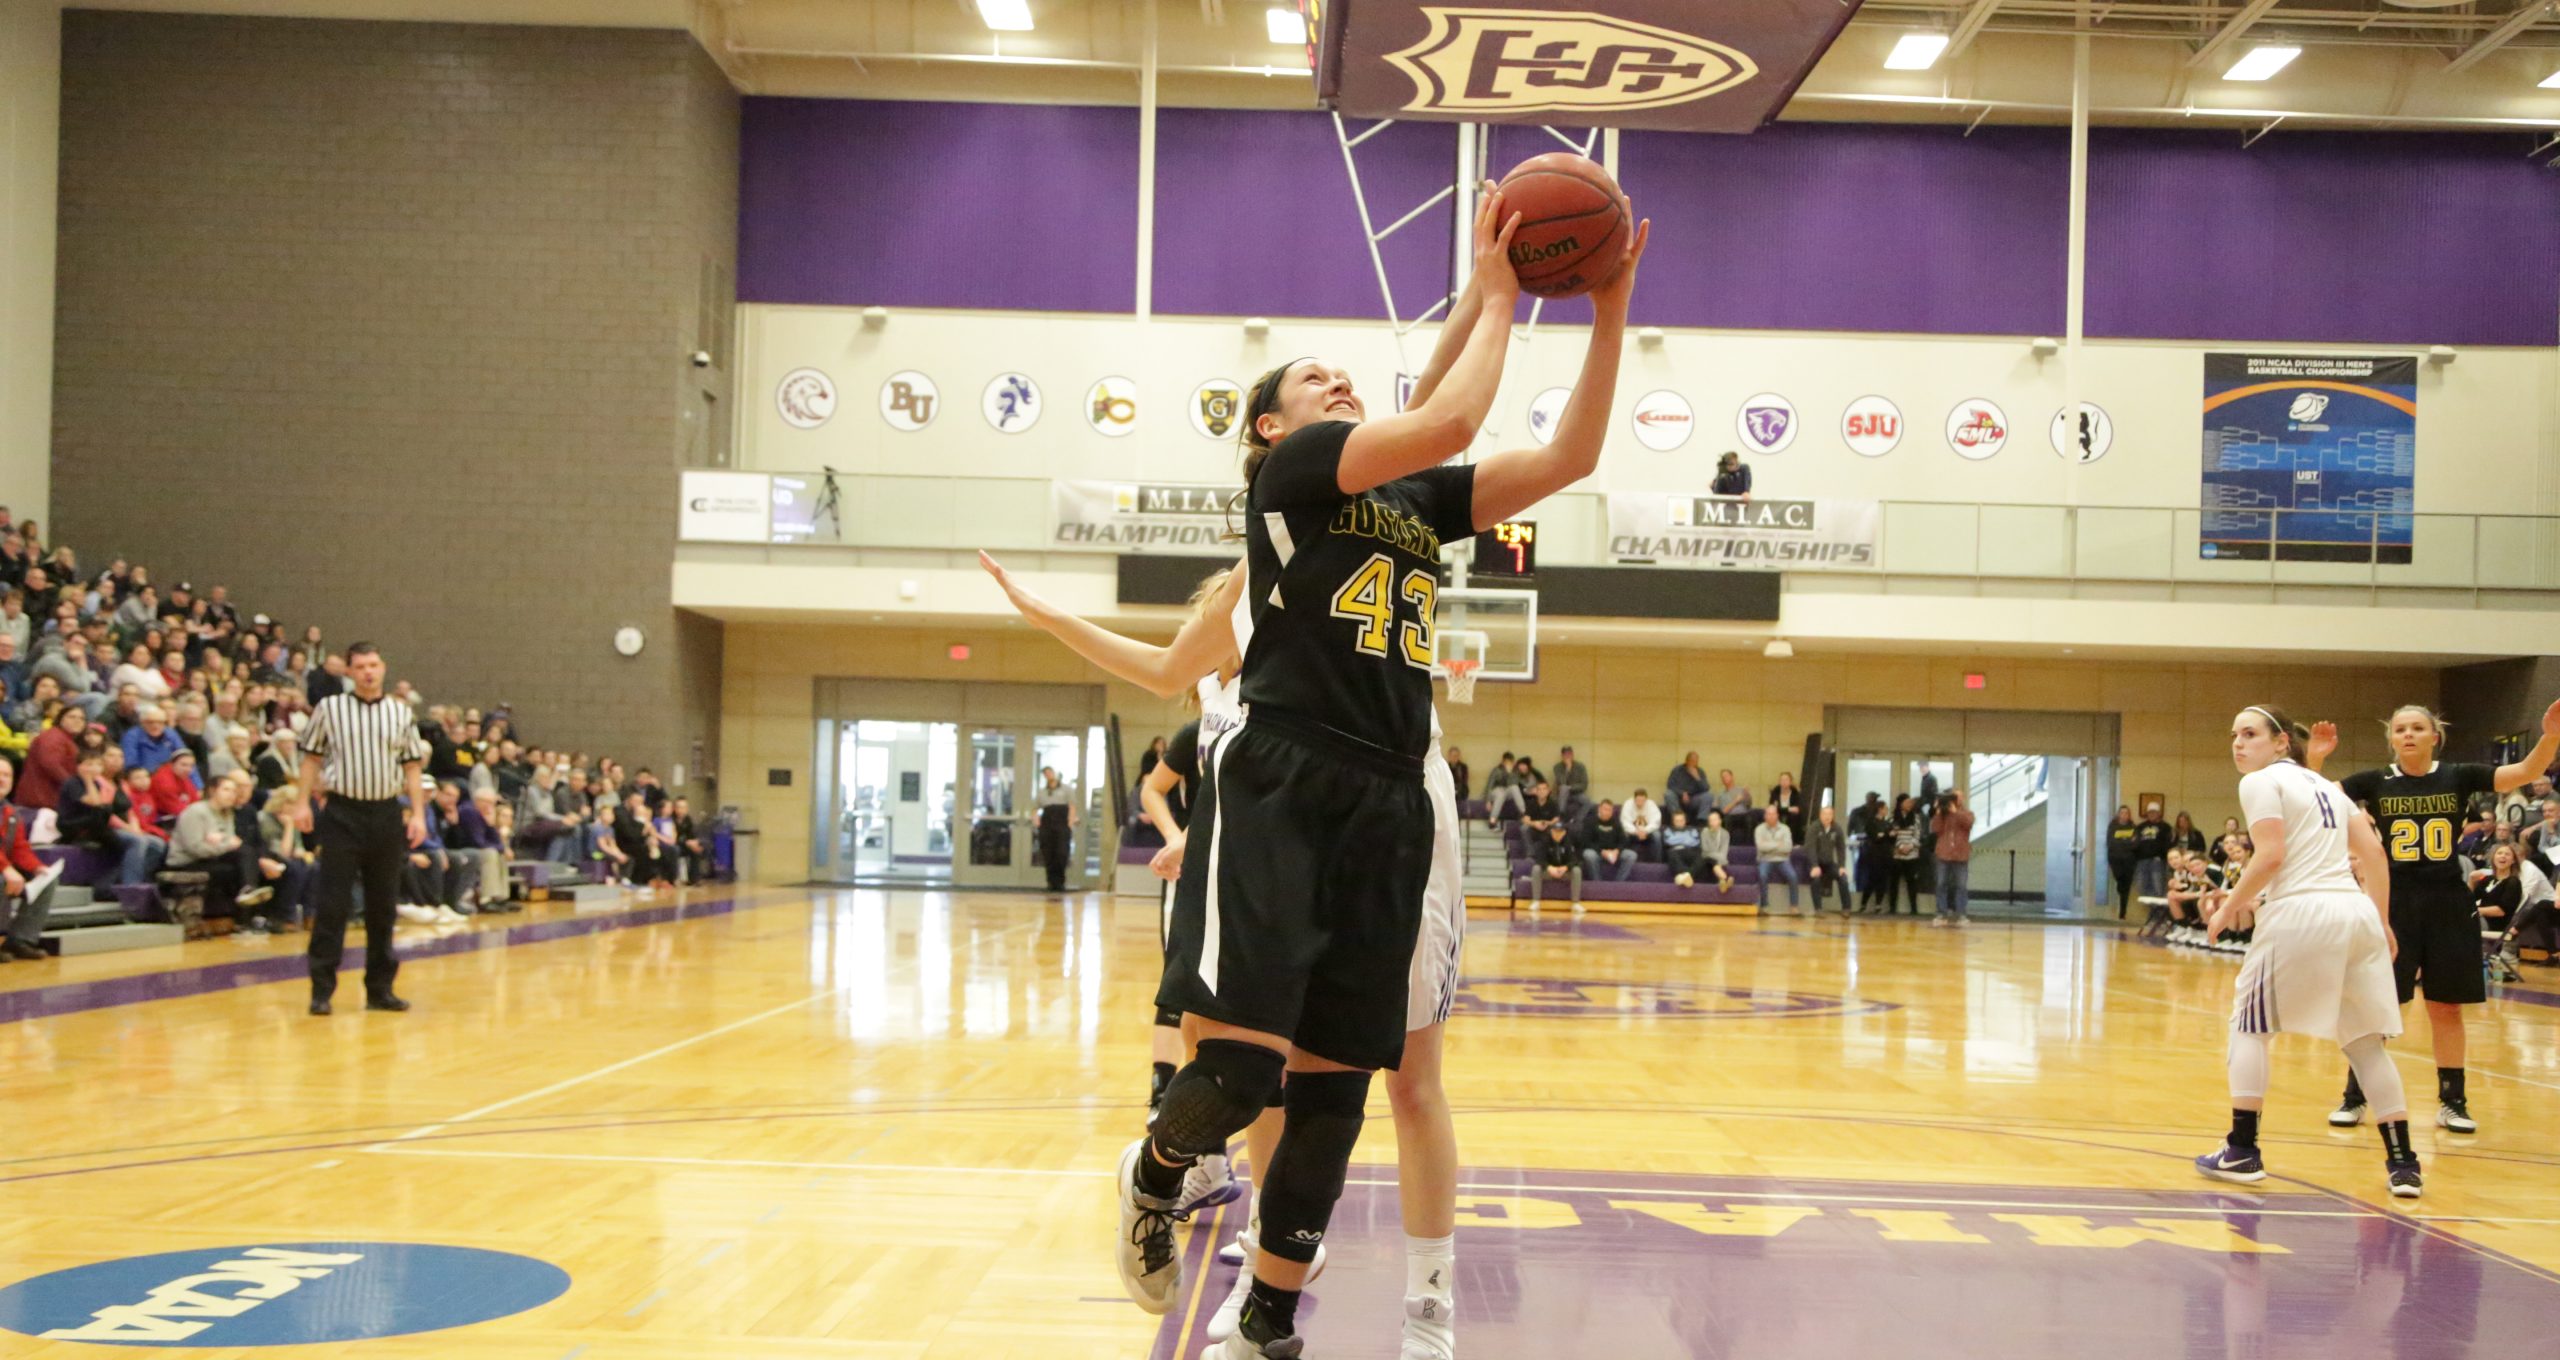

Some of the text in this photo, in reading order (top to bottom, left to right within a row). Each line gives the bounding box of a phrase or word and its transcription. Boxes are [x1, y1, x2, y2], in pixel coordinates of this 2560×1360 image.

[2247, 359, 2266, 367] 2011
[2267, 359, 2293, 367] NCAA
[2294, 360, 2334, 368] DIVISION
[2346, 361, 2374, 369] MEN'S
[2247, 367, 2374, 376] BASKETBALL CHAMPIONSHIP
[890, 381, 934, 424] BU
[1847, 413, 1897, 438] SJU
[2296, 470, 2319, 481] UST
[1507, 543, 1524, 573] 7
[1610, 535, 1873, 562] CHAMPIONSHIPS
[1330, 552, 1439, 671] 43
[2379, 793, 2458, 817] GUSTAVUS
[2390, 817, 2453, 861] 20
[37, 1247, 366, 1342] NCAA
